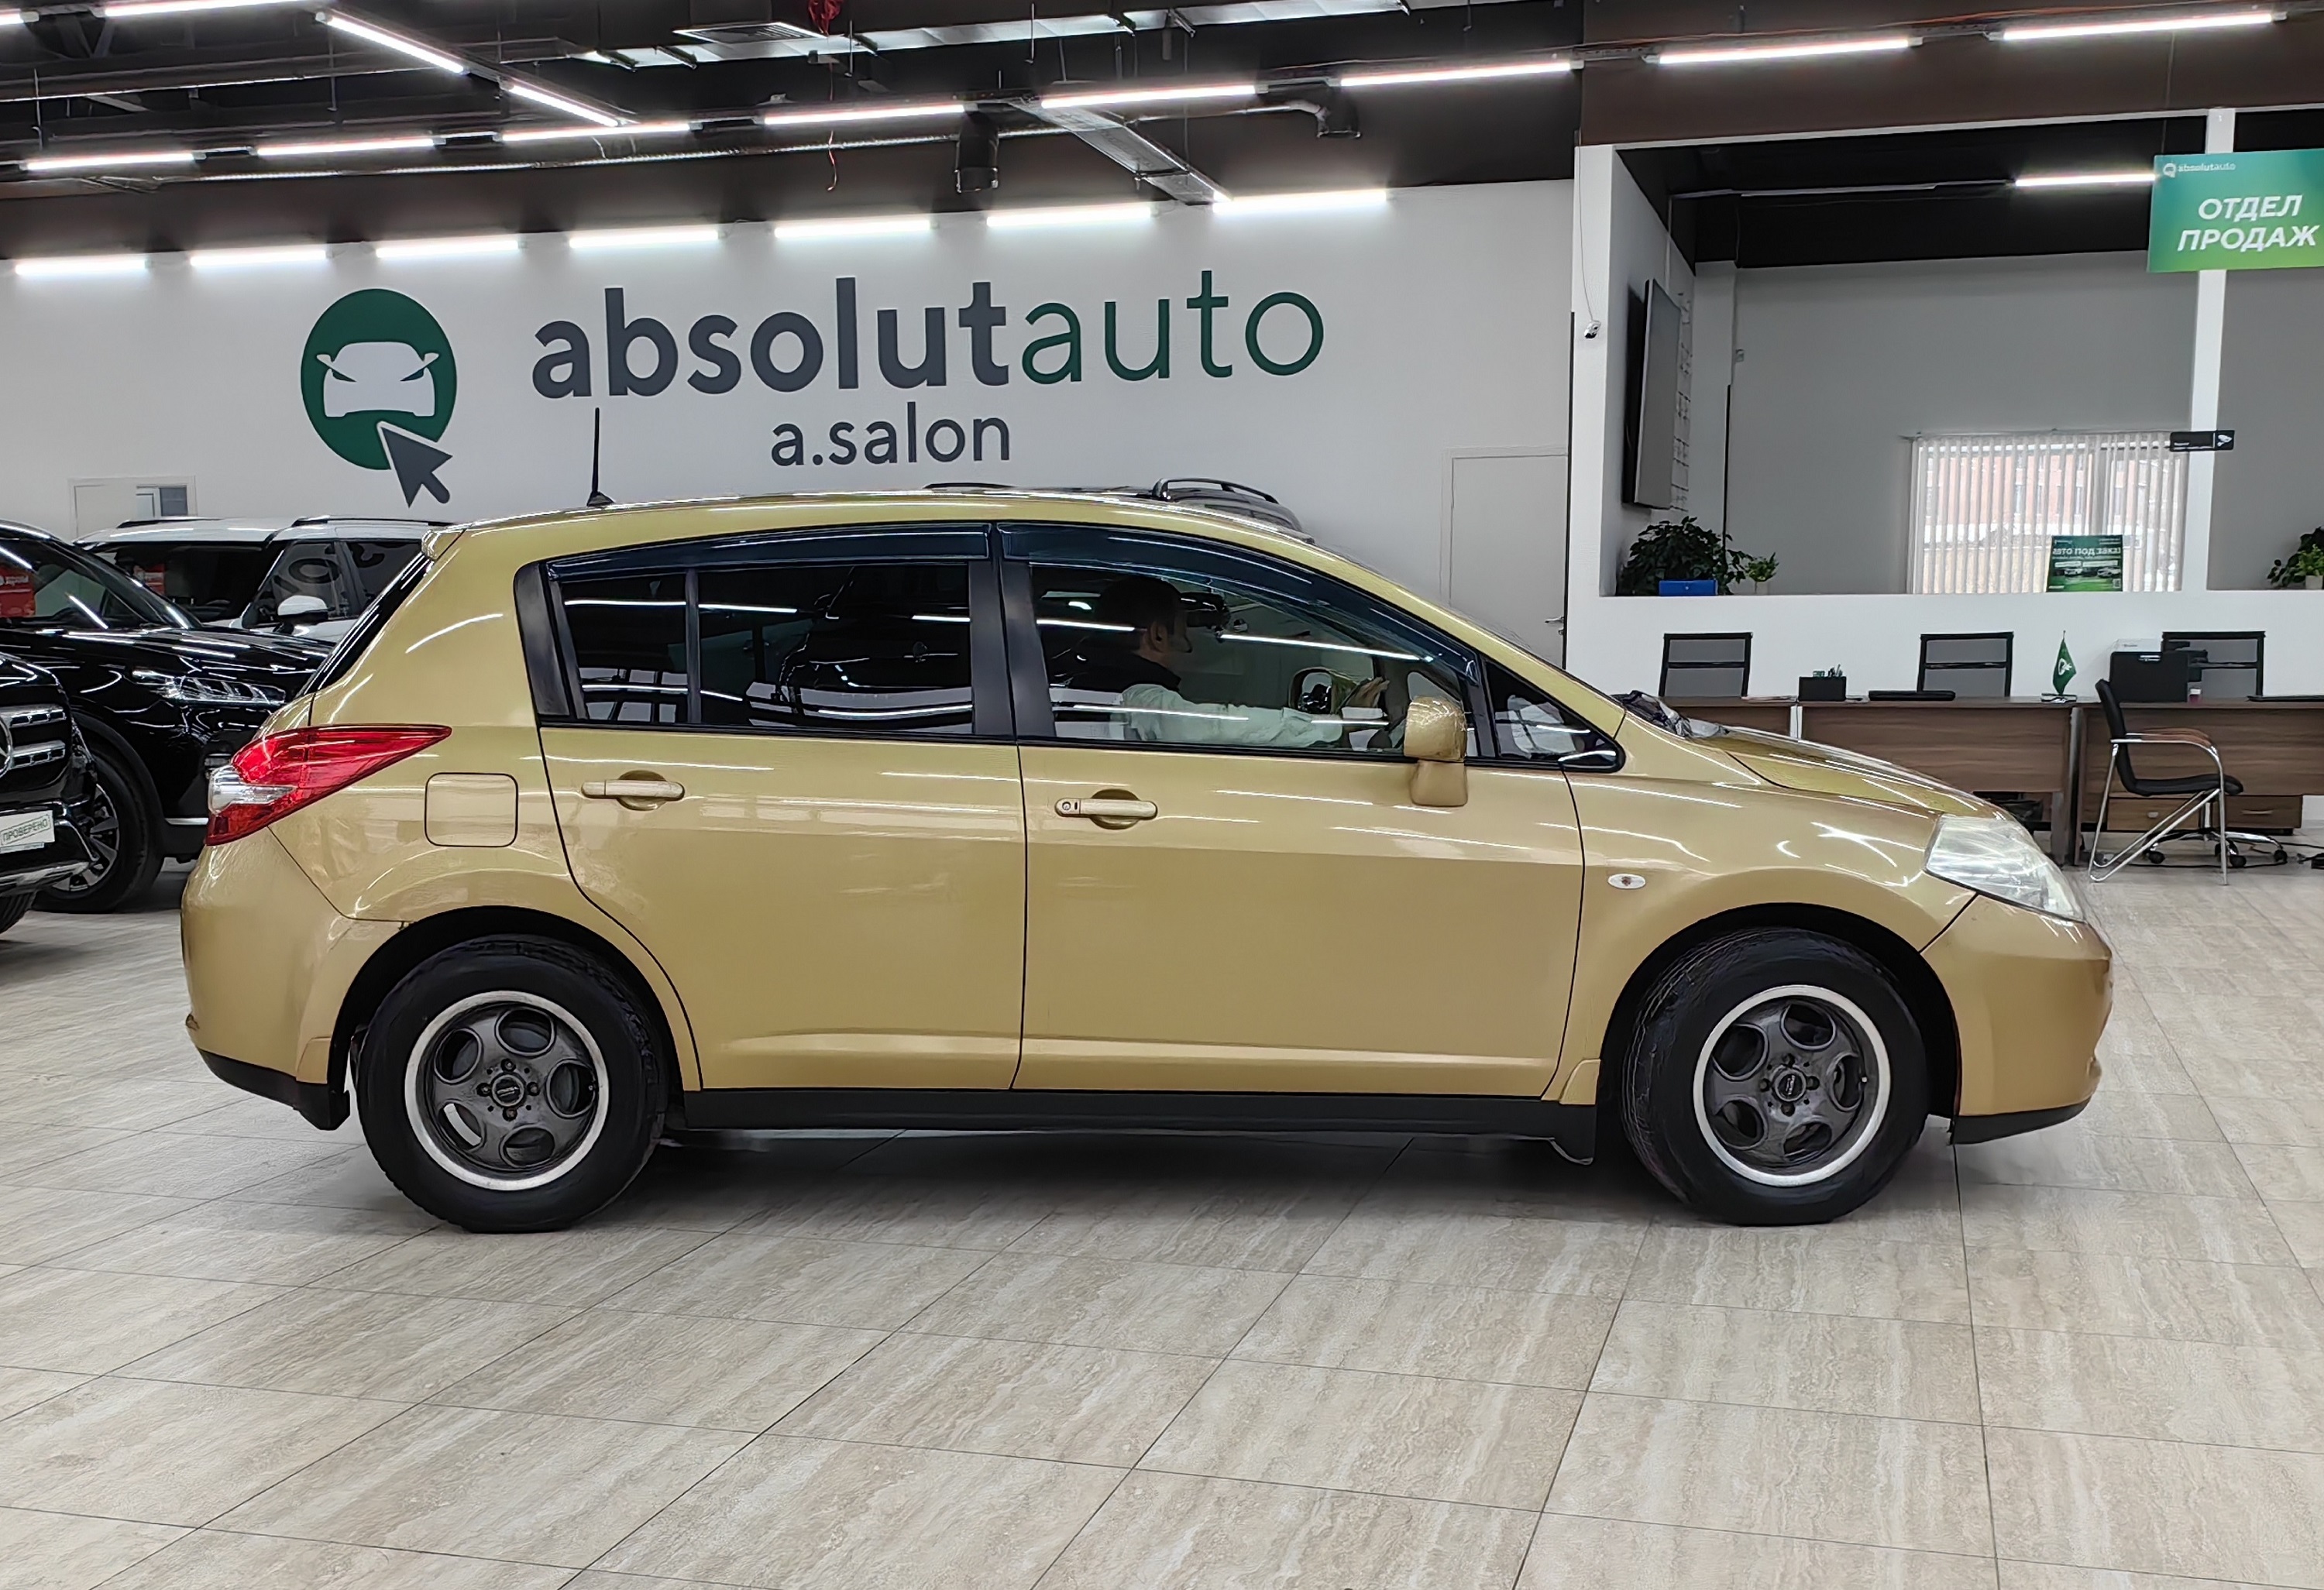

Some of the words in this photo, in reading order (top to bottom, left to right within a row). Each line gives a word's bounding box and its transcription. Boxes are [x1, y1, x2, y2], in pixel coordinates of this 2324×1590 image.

[2178, 162, 2236, 172] absolutauto
[2198, 194, 2303, 222] ОТДЕЛ
[2177, 225, 2320, 252] ПРОДАЖ
[531, 270, 1324, 399] absolutauto
[771, 400, 1010, 466] a.salon
[2075, 547, 2095, 556] под
